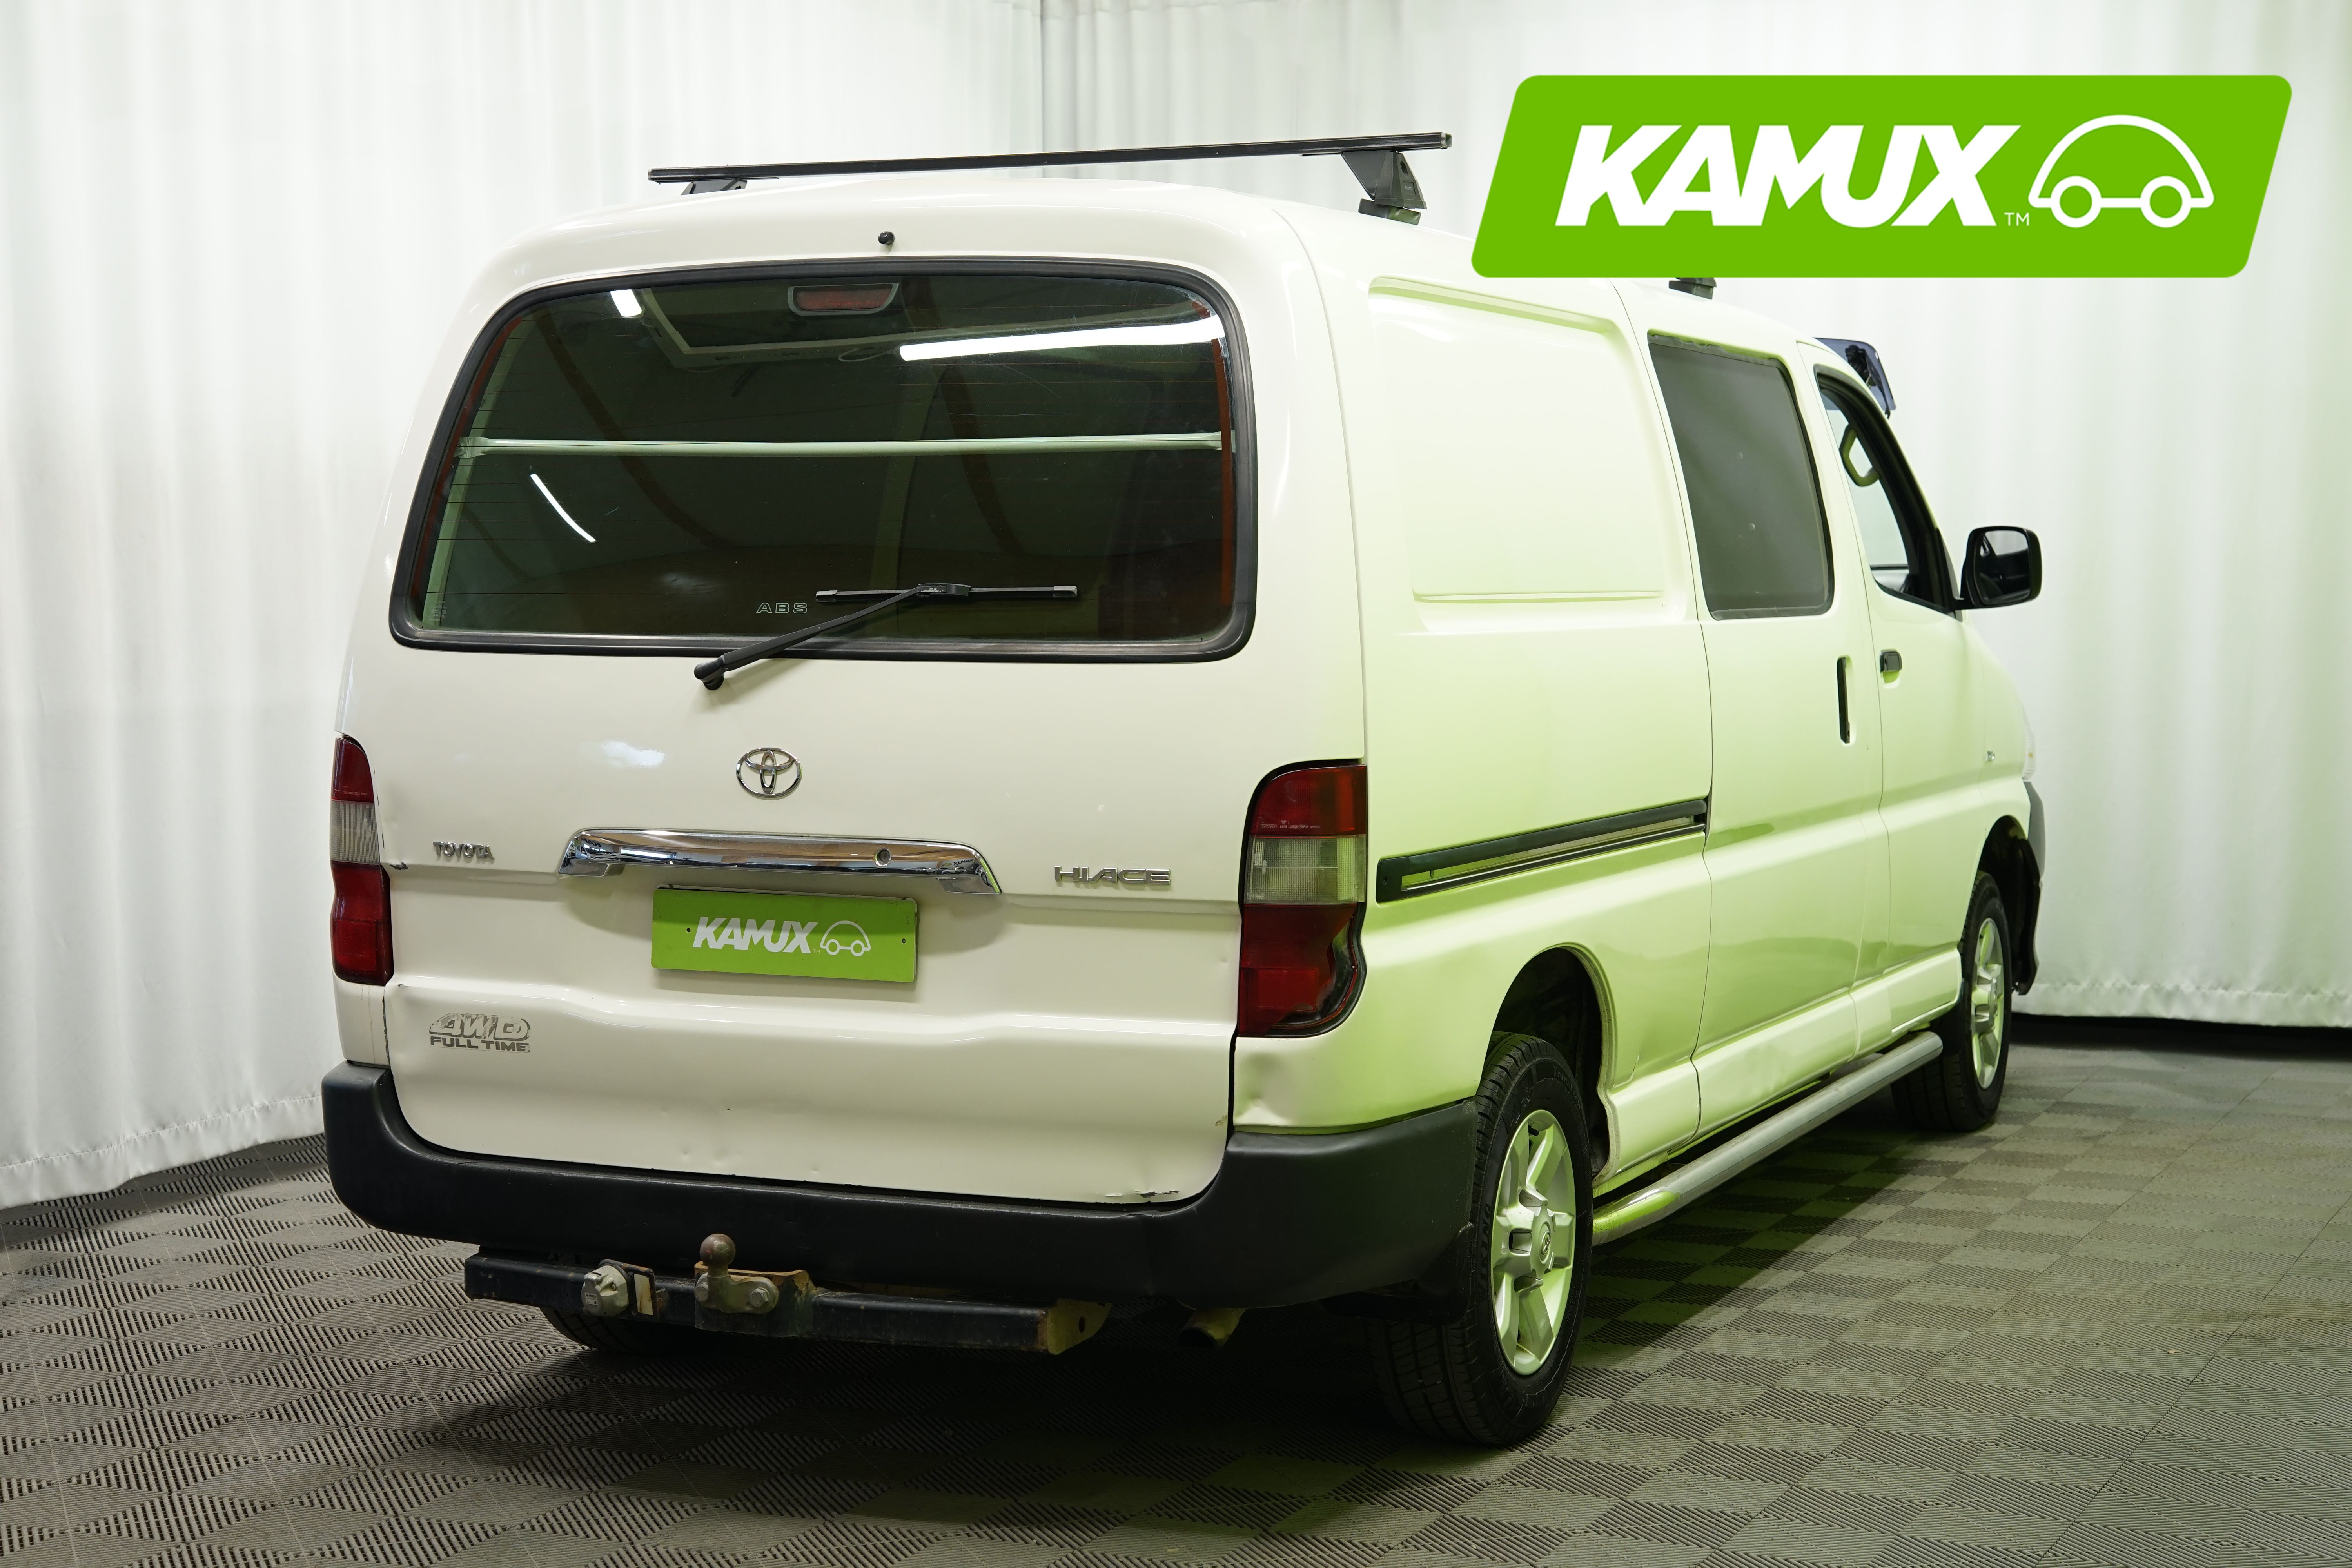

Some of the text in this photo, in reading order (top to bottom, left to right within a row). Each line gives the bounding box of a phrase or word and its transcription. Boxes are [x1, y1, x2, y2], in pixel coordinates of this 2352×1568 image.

[756, 602, 808, 614] ABS
[433, 842, 495, 860] TOYOTA
[1054, 866, 1171, 884] HIACE
[693, 916, 818, 954] KAMUX
[429, 1012, 530, 1041] 4WD
[430, 1036, 530, 1052] FULL TIME
